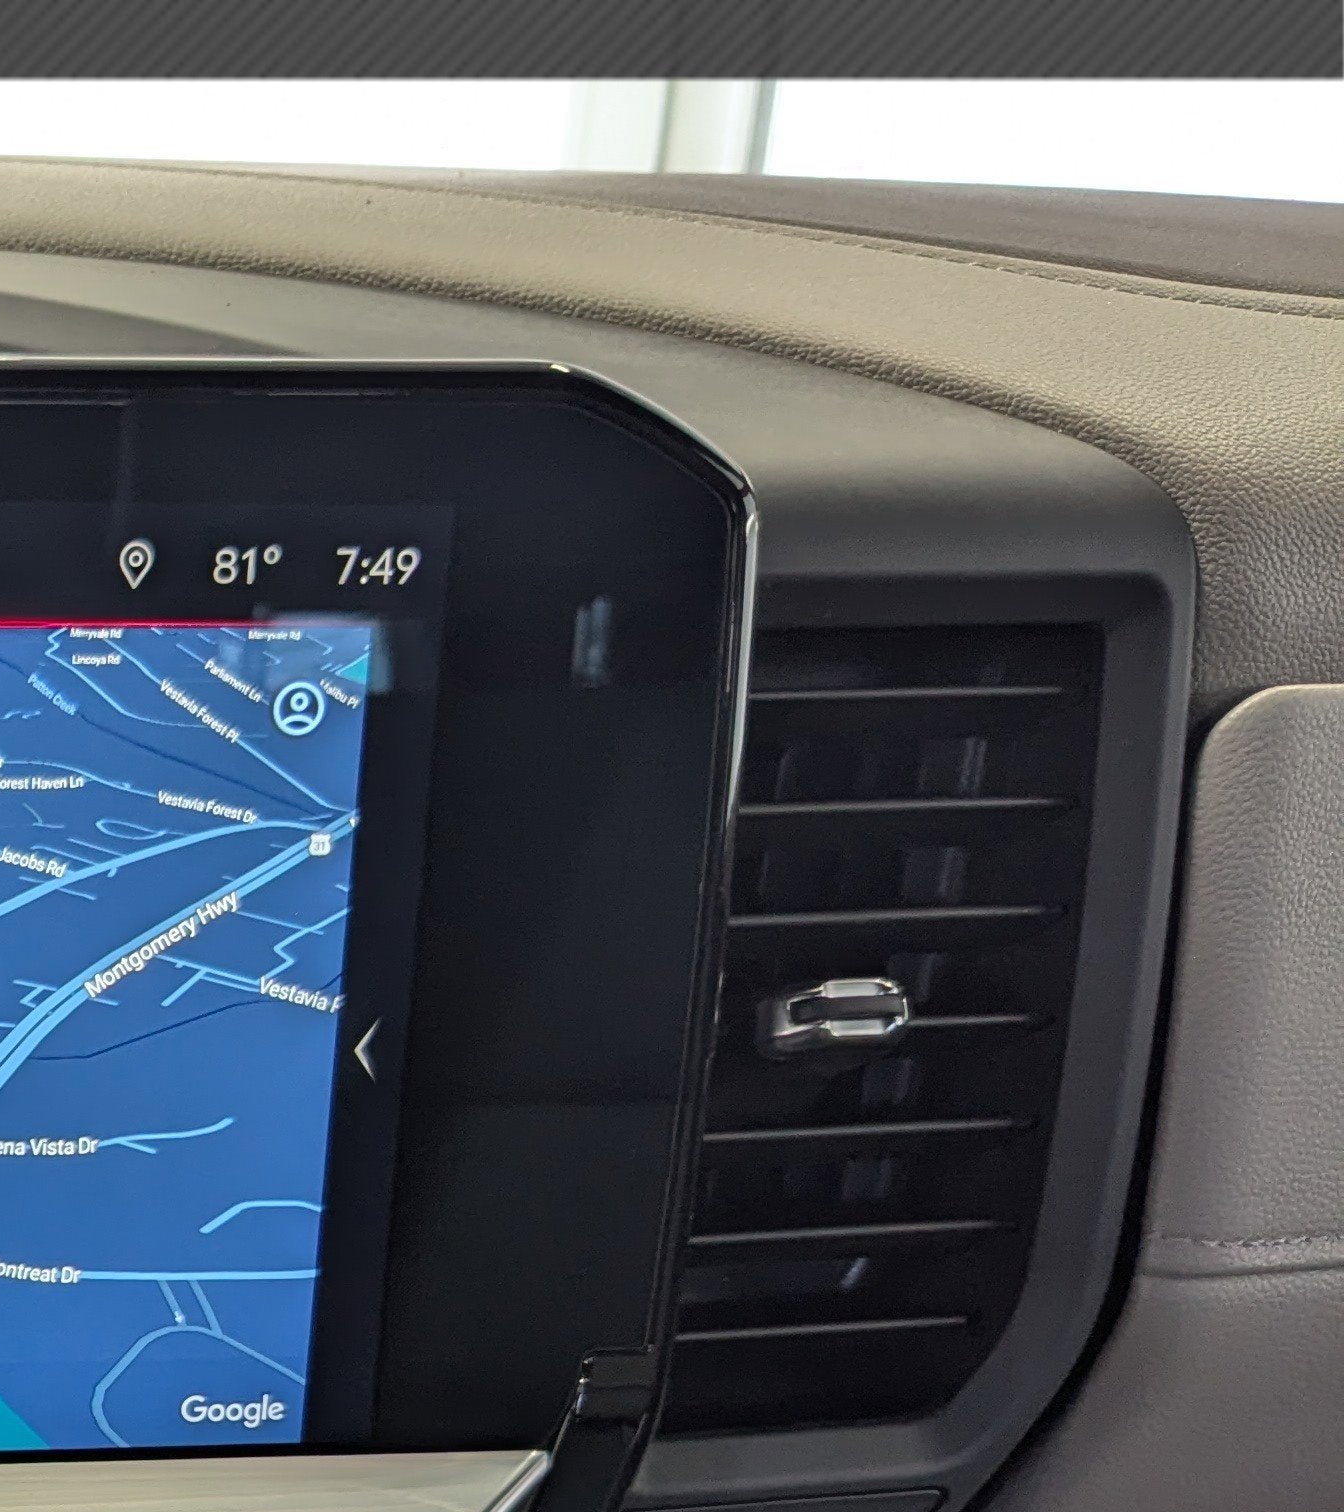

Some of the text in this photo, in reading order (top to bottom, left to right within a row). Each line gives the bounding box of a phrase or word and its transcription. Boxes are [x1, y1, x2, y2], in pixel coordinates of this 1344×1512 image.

[336, 547, 421, 585] 7:49
[160, 679, 201, 716] Vestavia
[198, 707, 232, 738] Forest
[32, 778, 66, 789] Haven
[68, 777, 84, 788] Ln
[158, 791, 257, 824] Vestavia Forest Dr
[44, 861, 67, 879] Rd
[84, 891, 239, 998] Montgomery Hwy
[259, 975, 327, 1012] Vestavia
[29, 1138, 74, 1155] Vista
[78, 1137, 98, 1155] Dr
[60, 1266, 82, 1284] Dr
[181, 1394, 285, 1428] Google
